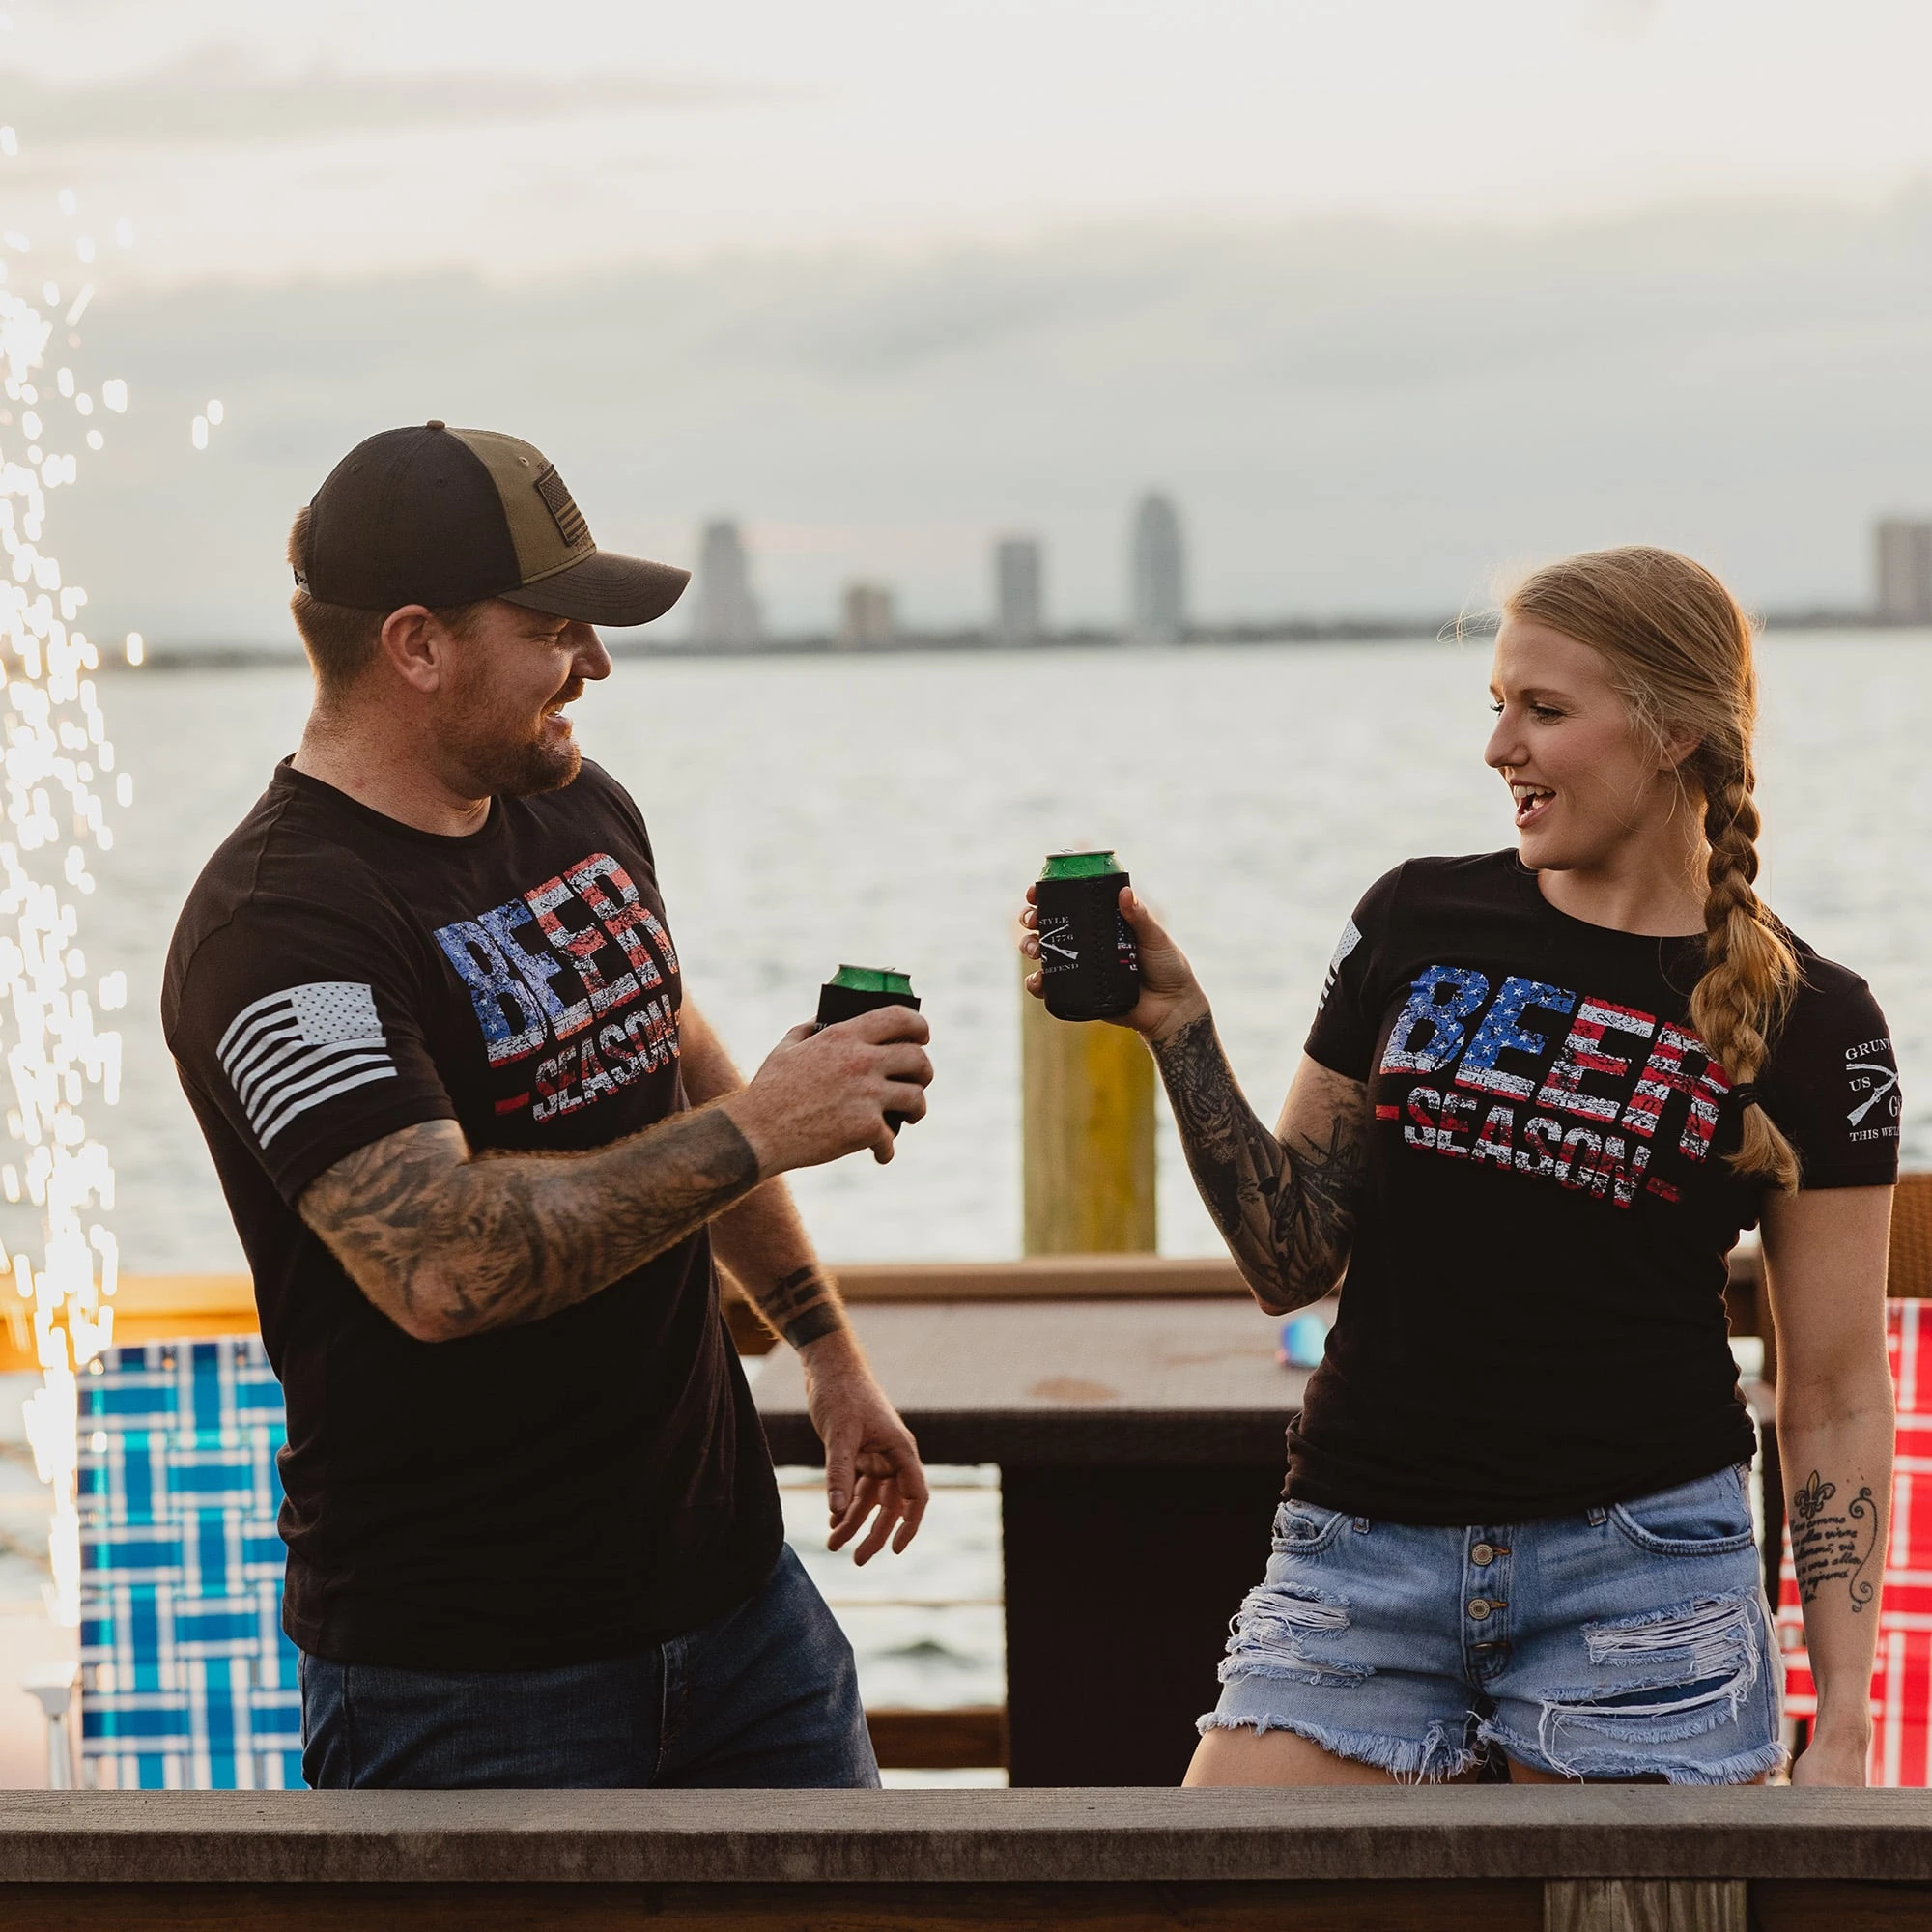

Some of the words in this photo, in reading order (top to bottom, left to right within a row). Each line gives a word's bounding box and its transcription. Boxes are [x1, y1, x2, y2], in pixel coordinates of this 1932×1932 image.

[434, 852, 678, 1068] BEER
[1051, 934, 1074, 943] 1776
[532, 993, 681, 1123] SEASON
[1379, 965, 1732, 1163] BEER
[1848, 1076, 1871, 1092] US
[1404, 1085, 1652, 1209] SEASON
[1849, 1128, 1879, 1142] THIS
